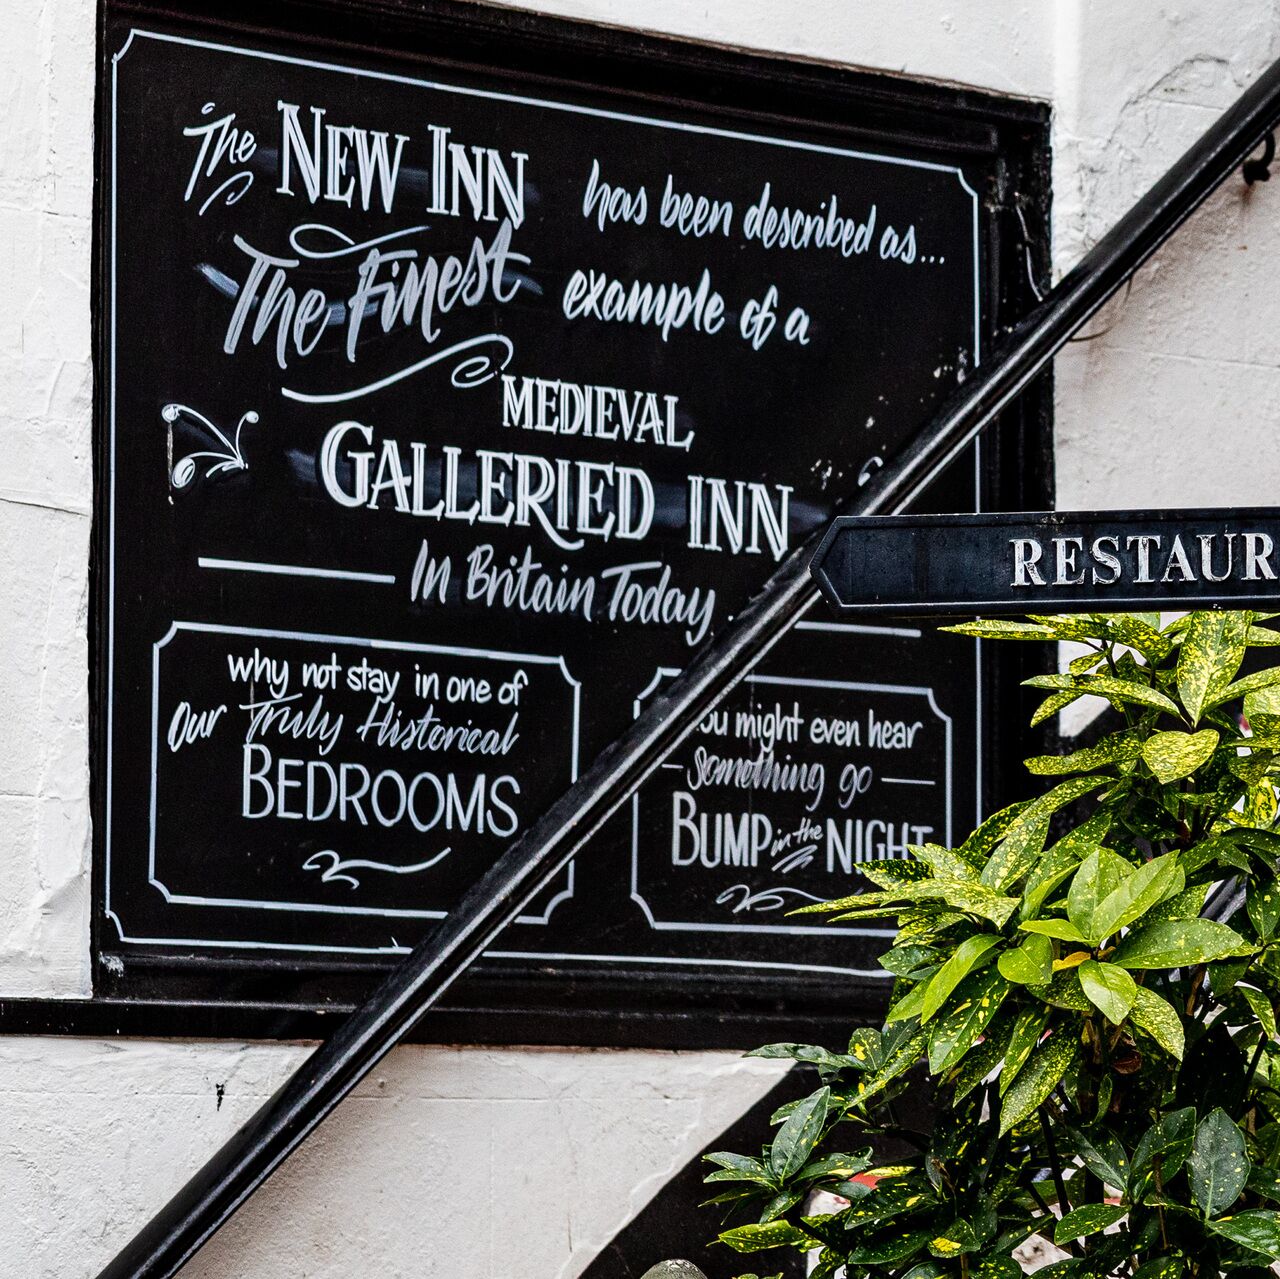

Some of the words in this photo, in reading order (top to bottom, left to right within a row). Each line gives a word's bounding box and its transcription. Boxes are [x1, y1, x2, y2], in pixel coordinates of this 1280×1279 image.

[183, 113, 257, 201] The
[276, 100, 409, 214] NEW
[427, 124, 529, 230] INN
[583, 158, 648, 232] has
[660, 173, 733, 237] been
[743, 181, 877, 258] described
[224, 233, 331, 370] The
[347, 217, 531, 362] Finest
[562, 267, 726, 342] example
[740, 284, 778, 351] of
[784, 307, 811, 345] a
[501, 374, 695, 452] MEDIEVAL
[320, 421, 655, 551] GALLERIED
[687, 475, 794, 562] INN
[410, 539, 452, 604] In
[466, 543, 595, 622] Britain
[227, 647, 289, 700] why
[302, 652, 342, 691] not
[347, 657, 400, 703] stay
[415, 663, 439, 701] in
[447, 677, 492, 703] one
[498, 669, 528, 706] of
[238, 692, 344, 756] Truly
[356, 695, 520, 756] Historical
[735, 701, 804, 753] might
[809, 715, 861, 747] even
[868, 708, 923, 749] hear
[242, 743, 521, 838] BEDROOMS
[839, 763, 874, 810] go
[672, 791, 773, 870] BUMP
[770, 827, 792, 857] in
[791, 817, 824, 843] the
